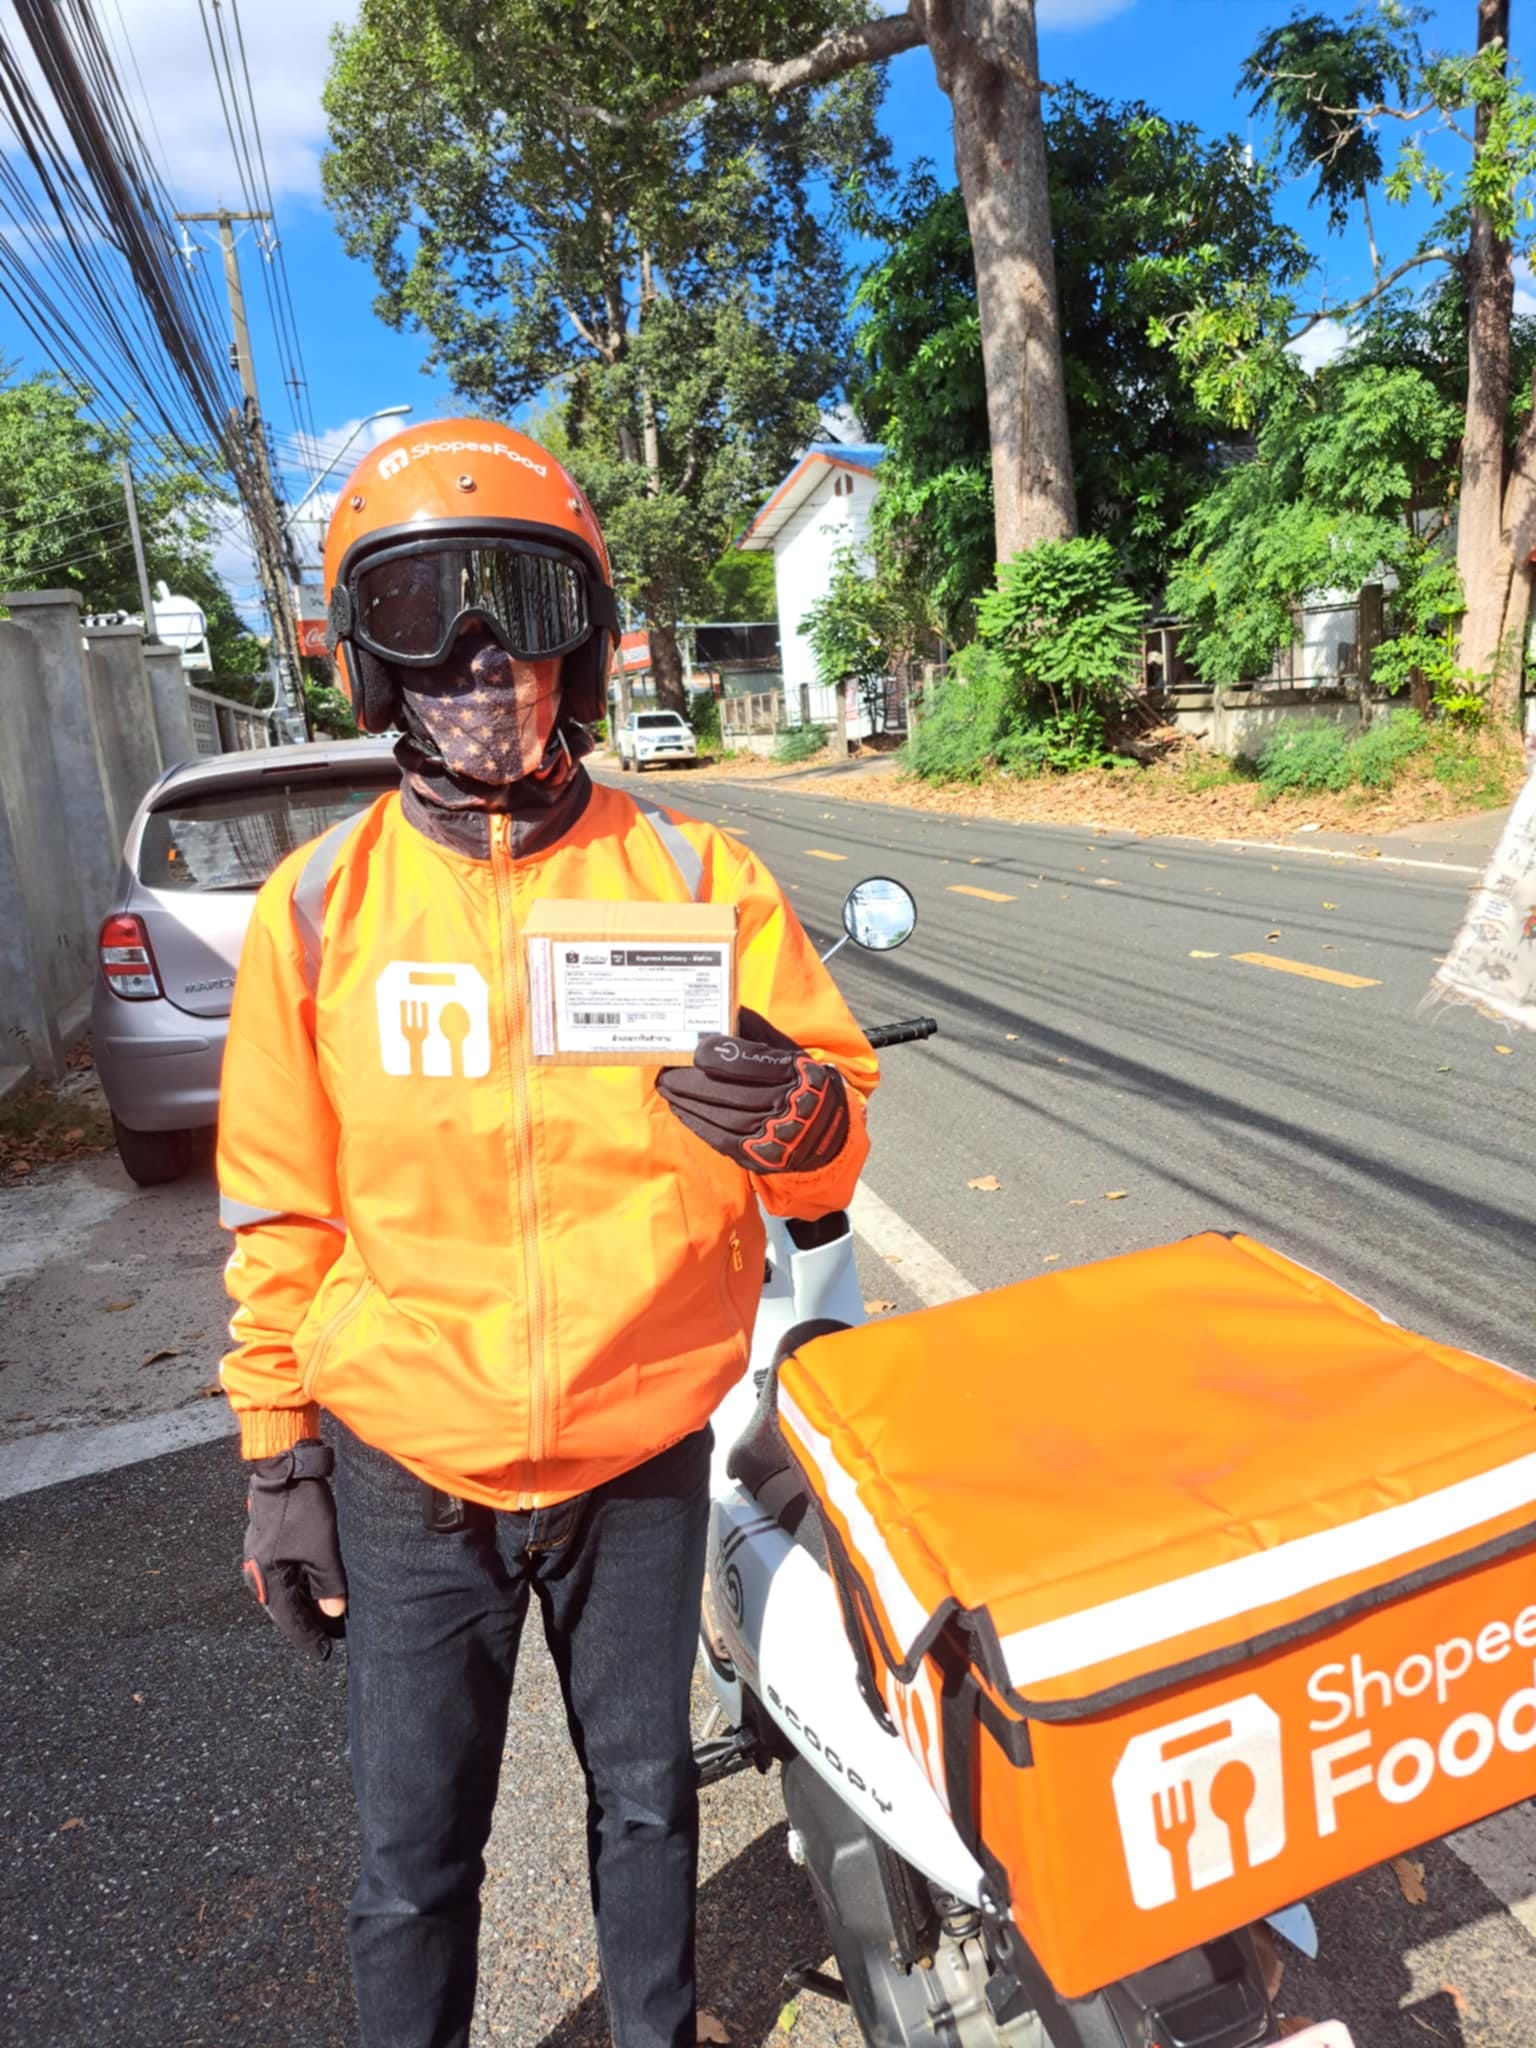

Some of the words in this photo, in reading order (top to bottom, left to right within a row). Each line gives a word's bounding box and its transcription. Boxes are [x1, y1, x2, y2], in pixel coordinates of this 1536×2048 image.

[411, 441, 547, 478] ShopeeFood
[1307, 1604, 1536, 1721] Shopee
[767, 1684, 893, 1814] SCOOPY
